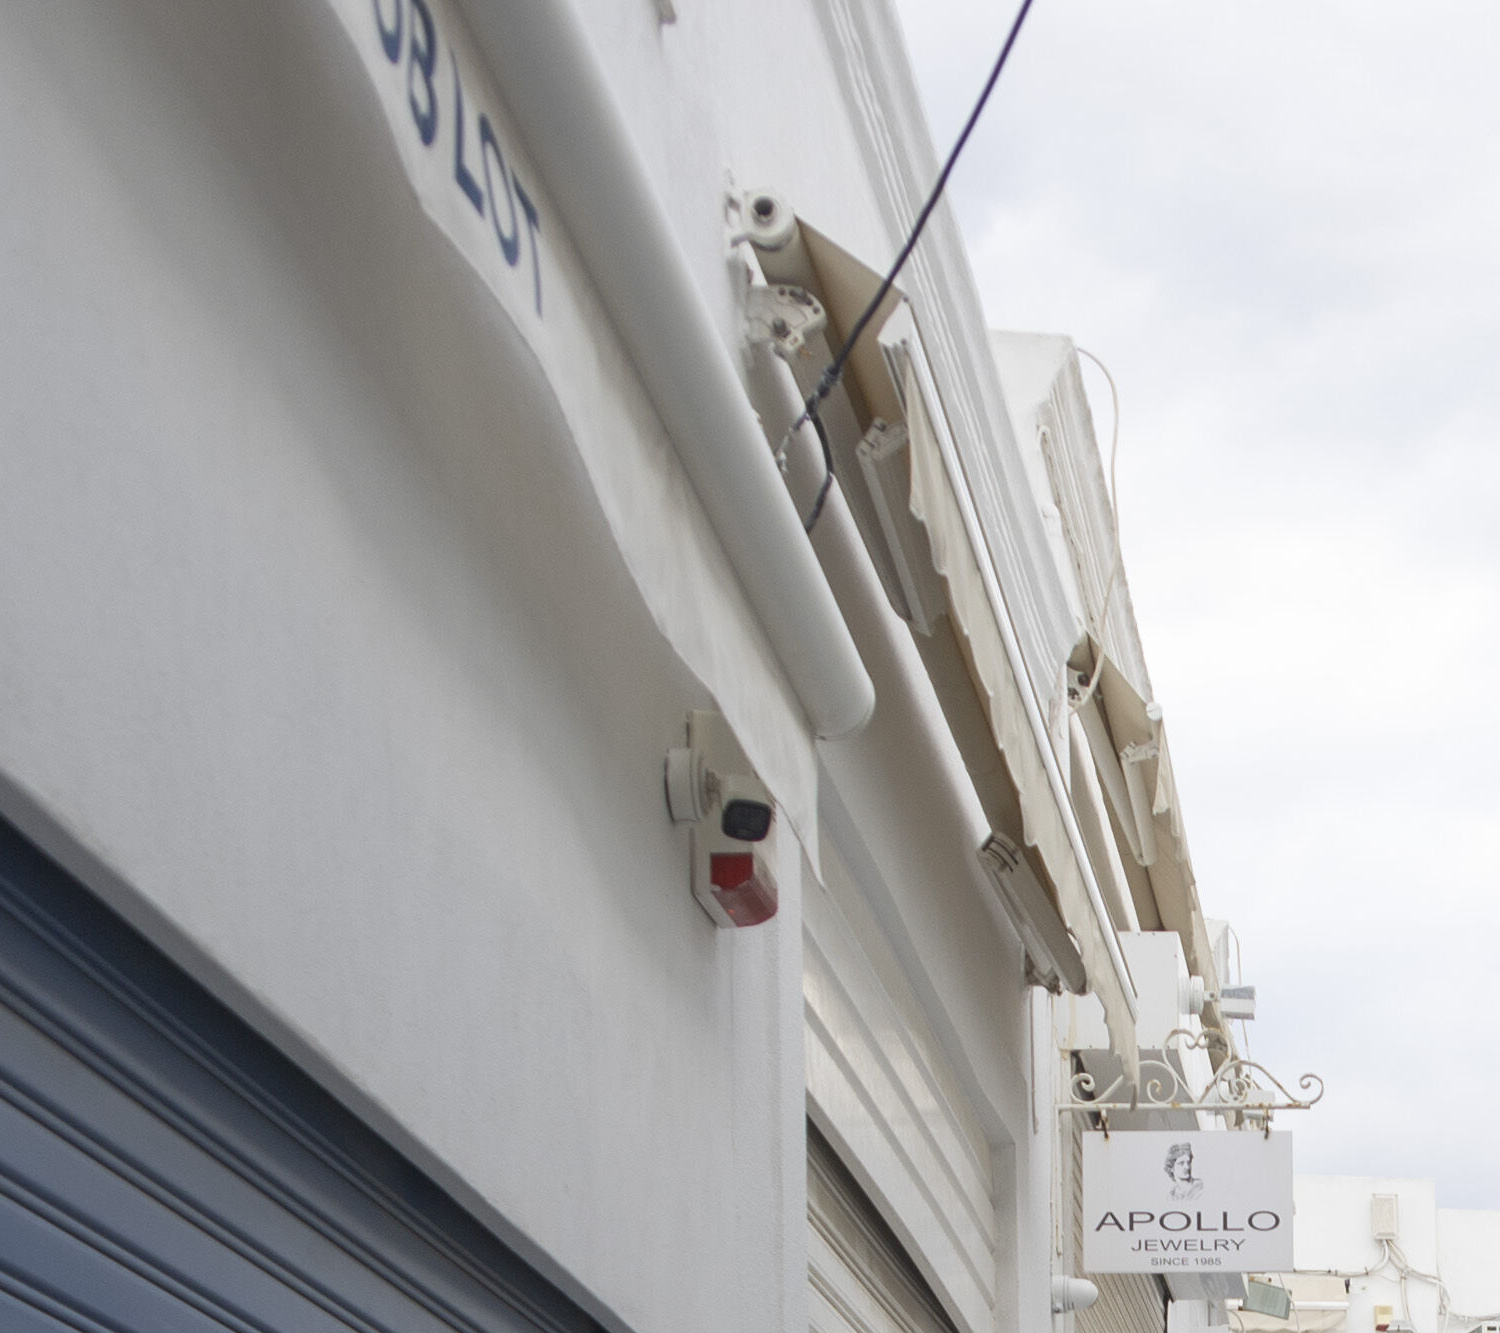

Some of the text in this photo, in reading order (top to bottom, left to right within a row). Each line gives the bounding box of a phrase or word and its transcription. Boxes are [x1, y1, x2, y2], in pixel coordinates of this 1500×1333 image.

[1095, 1211, 1281, 1232] APOLLO
[1131, 1239, 1246, 1252] JEWELRY
[1150, 1257, 1222, 1266] SINCE 1985
